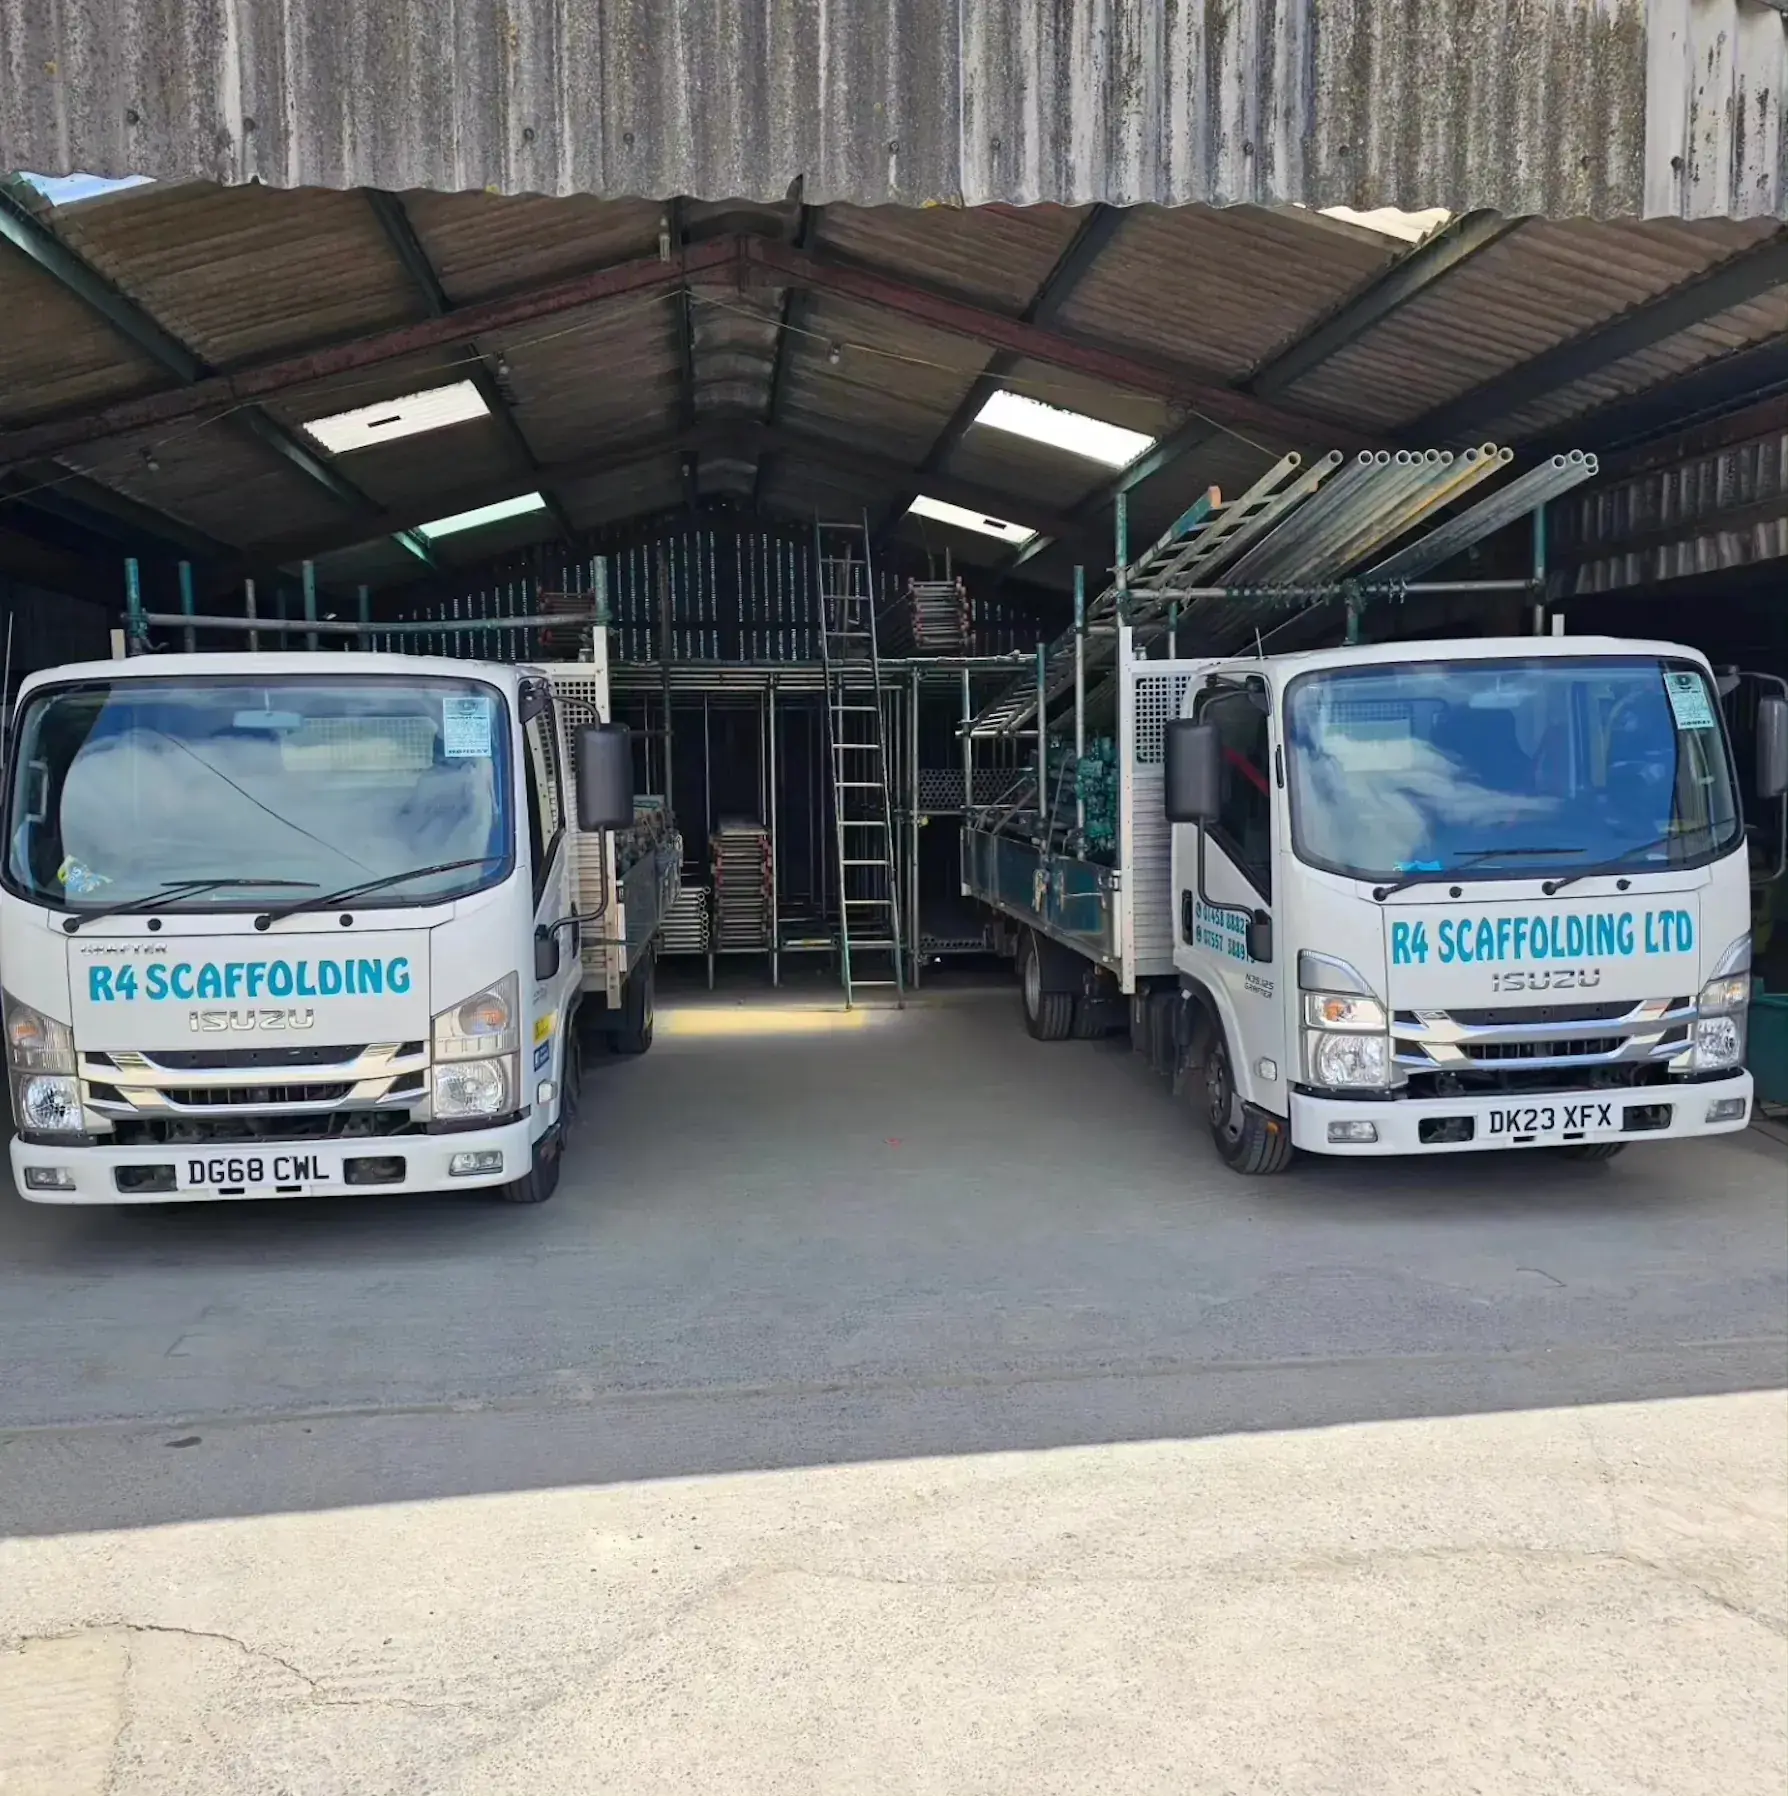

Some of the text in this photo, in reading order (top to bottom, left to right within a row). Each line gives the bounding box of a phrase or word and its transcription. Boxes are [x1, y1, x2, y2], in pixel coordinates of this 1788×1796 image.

[1392, 910, 1694, 964] R4 SCAFFOLDING LTD
[89, 957, 410, 1001] R4 SCAFFOLDING
[1492, 968, 1600, 992] ISUZU
[189, 1008, 314, 1032] ISUZU
[1490, 1103, 1611, 1134] DK23 XFX
[188, 1155, 330, 1184] DG68 CWL
